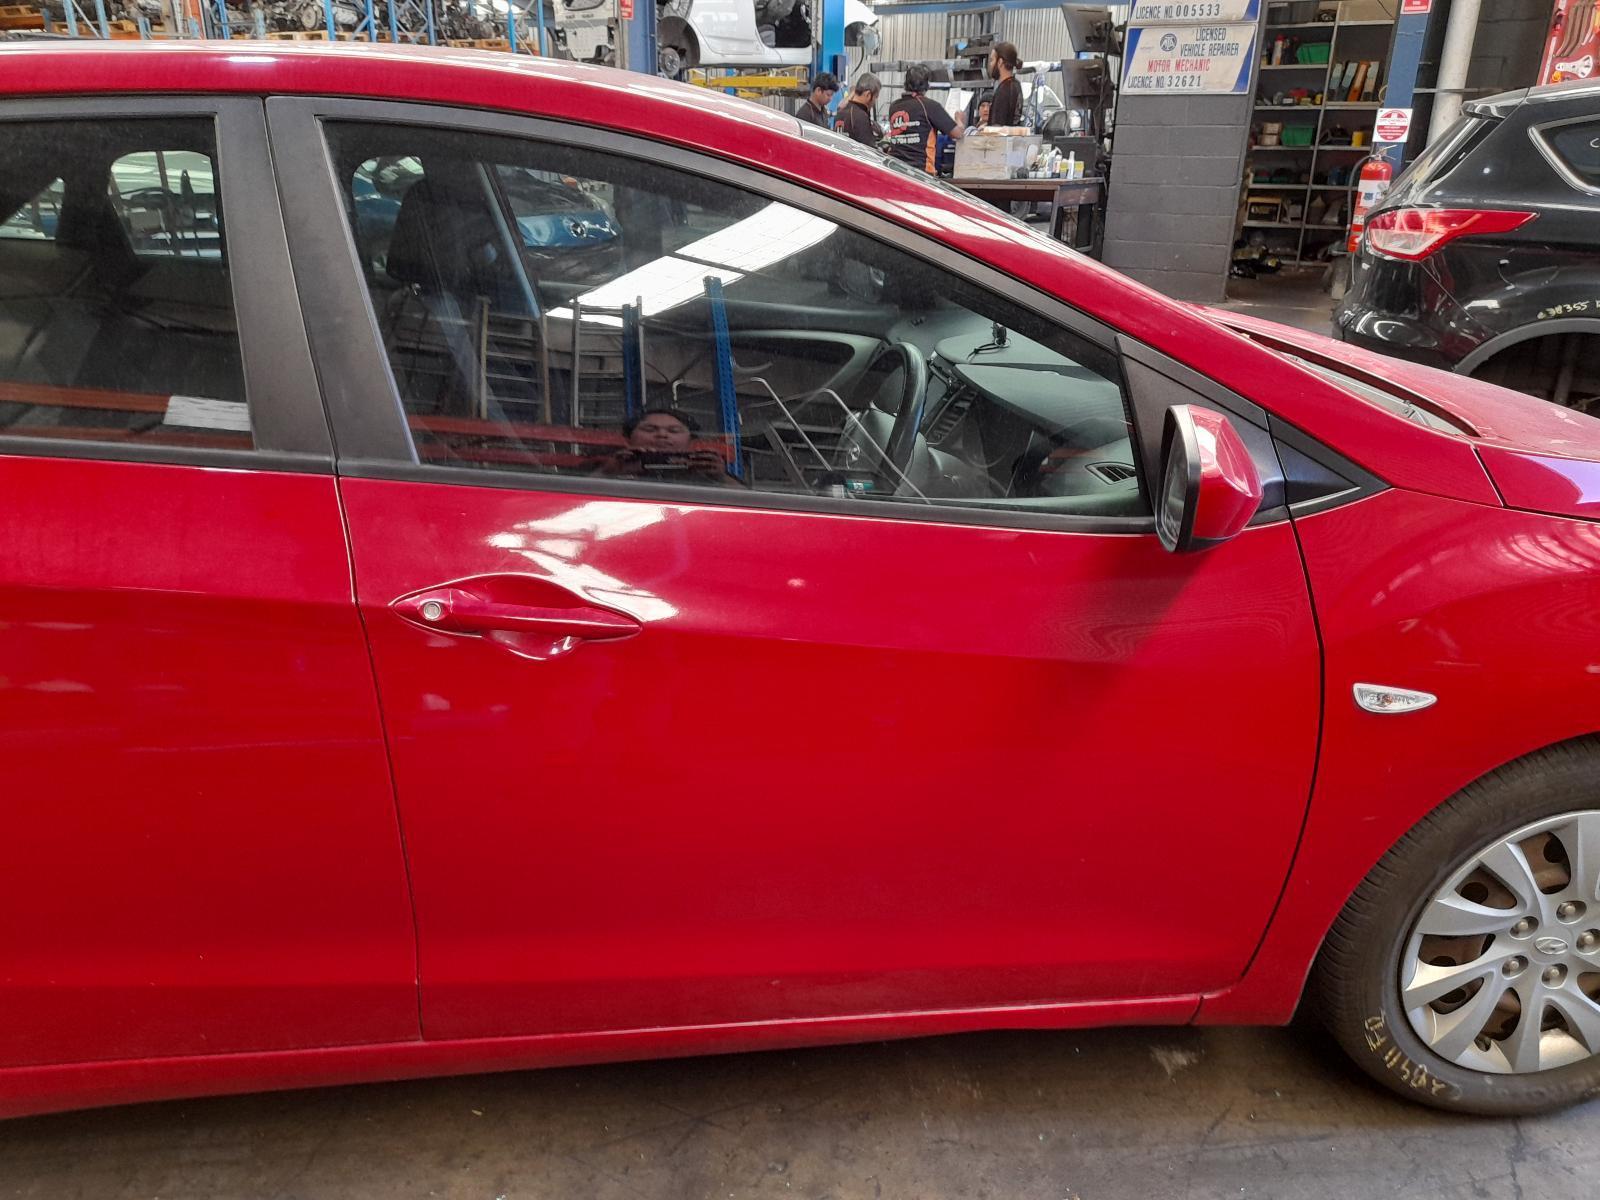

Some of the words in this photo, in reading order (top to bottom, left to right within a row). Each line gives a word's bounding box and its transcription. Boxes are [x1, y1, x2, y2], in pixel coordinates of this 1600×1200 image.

[1135, 6, 1161, 19] LICENCE
[1175, 4, 1220, 17] 005533
[1195, 28, 1227, 42] LICENSED
[1180, 44, 1206, 57] VEHICLE
[1208, 44, 1239, 56] REPAIRER
[1147, 59, 1171, 73] MOTOR
[1175, 58, 1211, 72] MECHANIC
[1127, 76, 1153, 89] LICENCE
[1167, 75, 1201, 88] 32621
